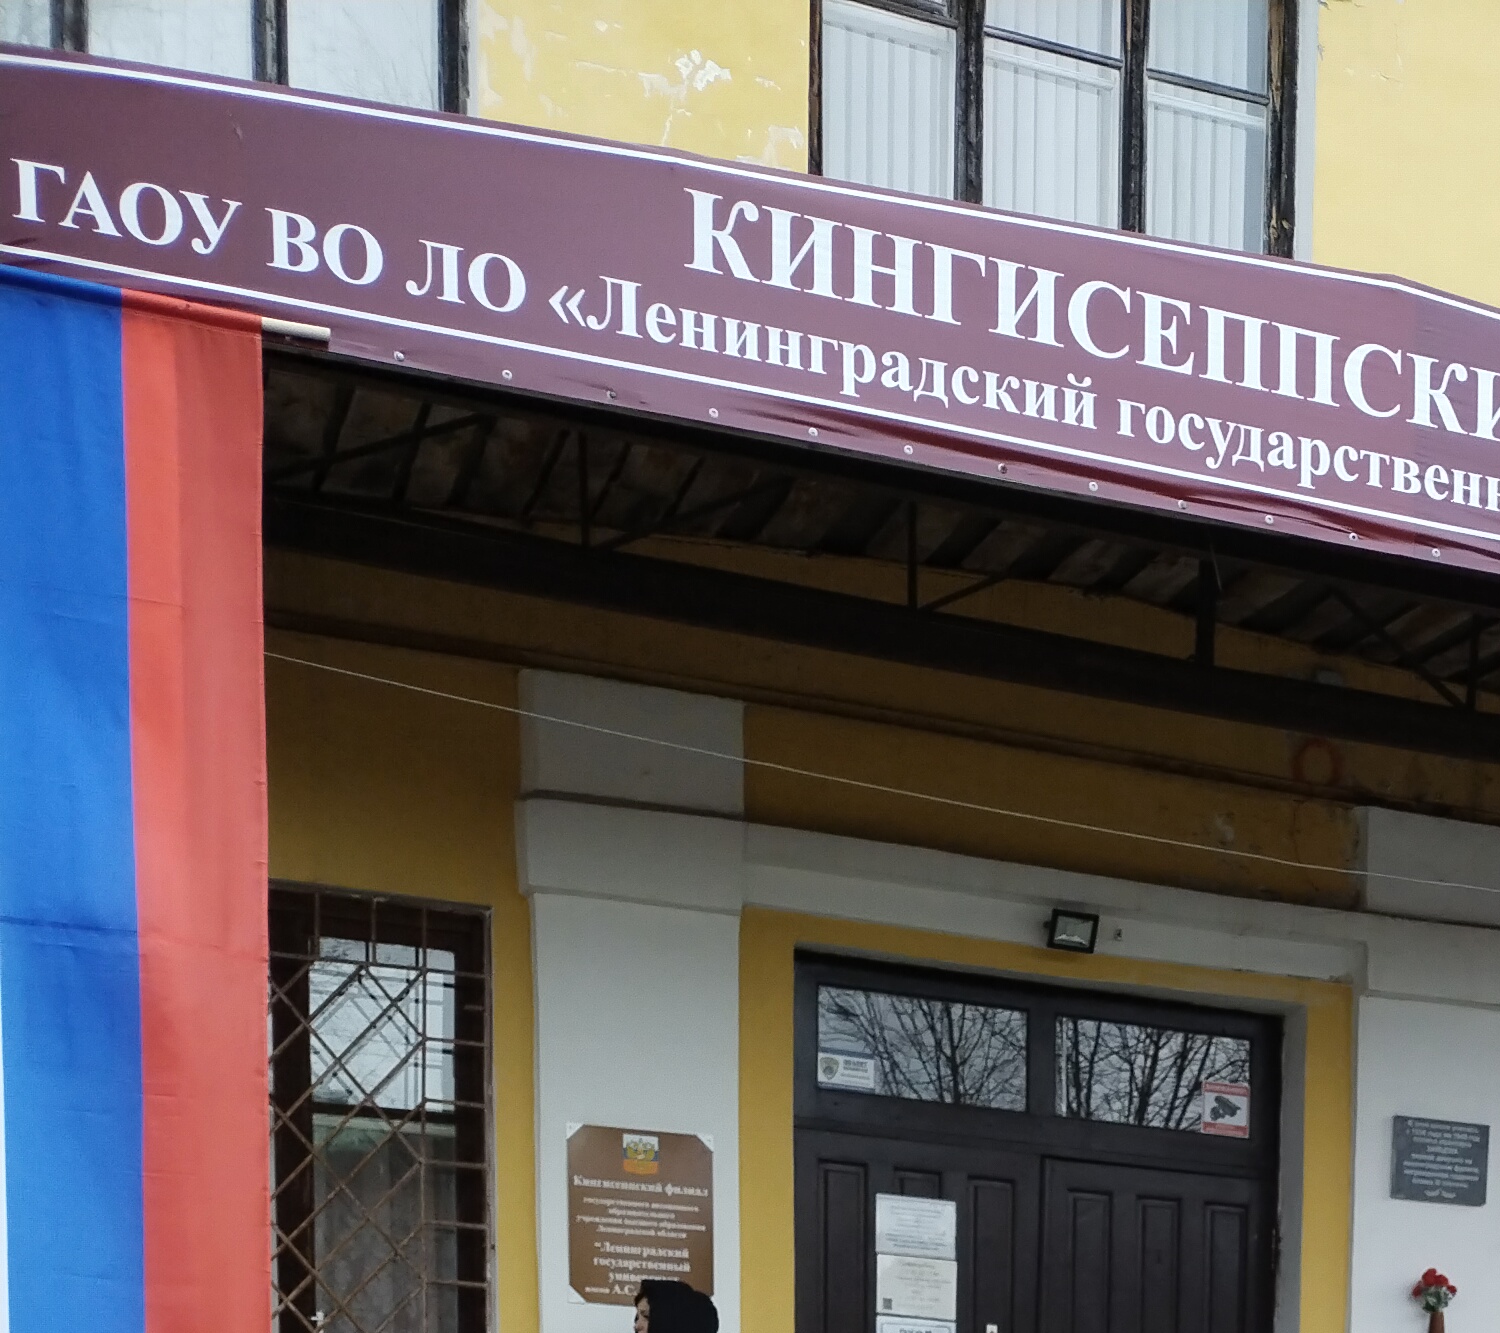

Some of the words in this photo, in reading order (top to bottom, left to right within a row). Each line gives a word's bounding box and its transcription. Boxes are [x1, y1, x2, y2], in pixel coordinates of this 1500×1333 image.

[11, 157, 242, 255] ГАОУ
[265, 208, 383, 285] ВО
[406, 240, 526, 312] ЛО
[549, 276, 1097, 429] «Ленинградский
